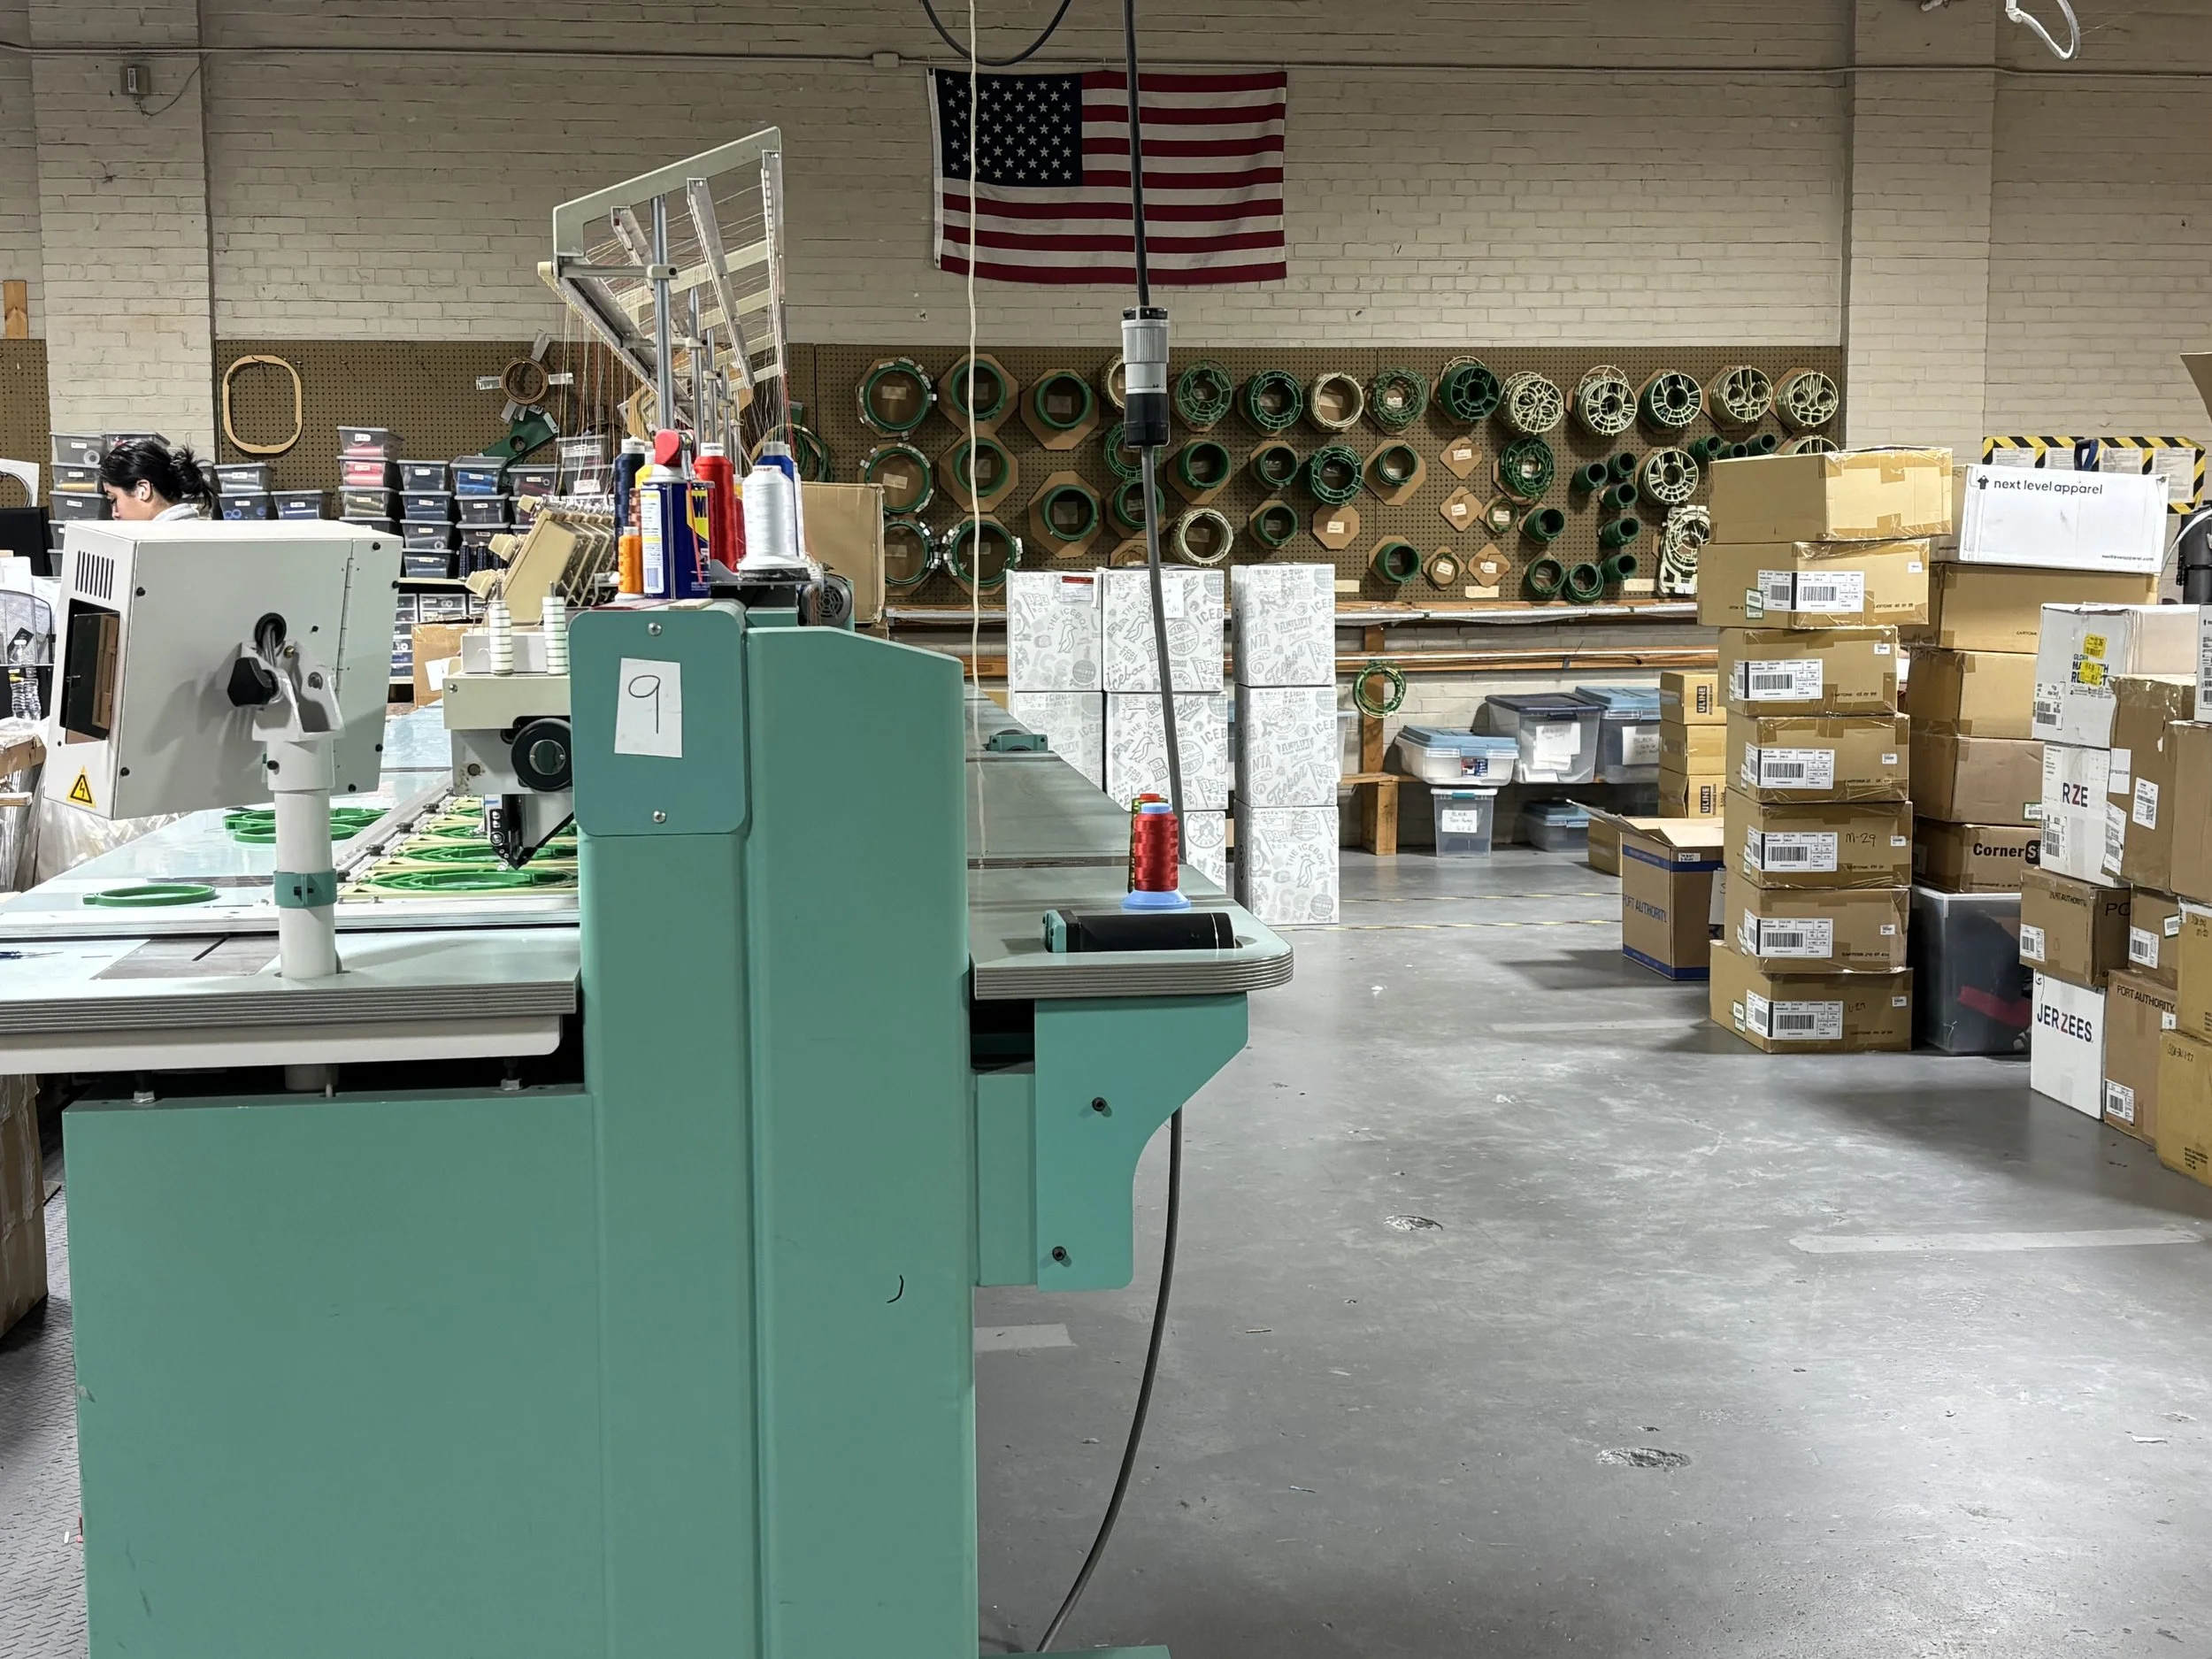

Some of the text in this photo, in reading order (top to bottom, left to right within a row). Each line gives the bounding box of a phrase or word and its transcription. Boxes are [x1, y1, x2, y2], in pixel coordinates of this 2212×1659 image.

[1993, 480, 2103, 495] next level apparel
[1047, 608, 1088, 631] THE ICEBOX
[1122, 602, 1138, 616] THE
[627, 675, 661, 733] 9
[1127, 721, 1165, 749] THE ICEBOX
[1286, 843, 1326, 866] THE ICEBOX
[1973, 841, 2040, 862] CornerS
[2116, 985, 2176, 1014] PORT AUTHORITY
[2037, 1002, 2093, 1043] JERZEES
